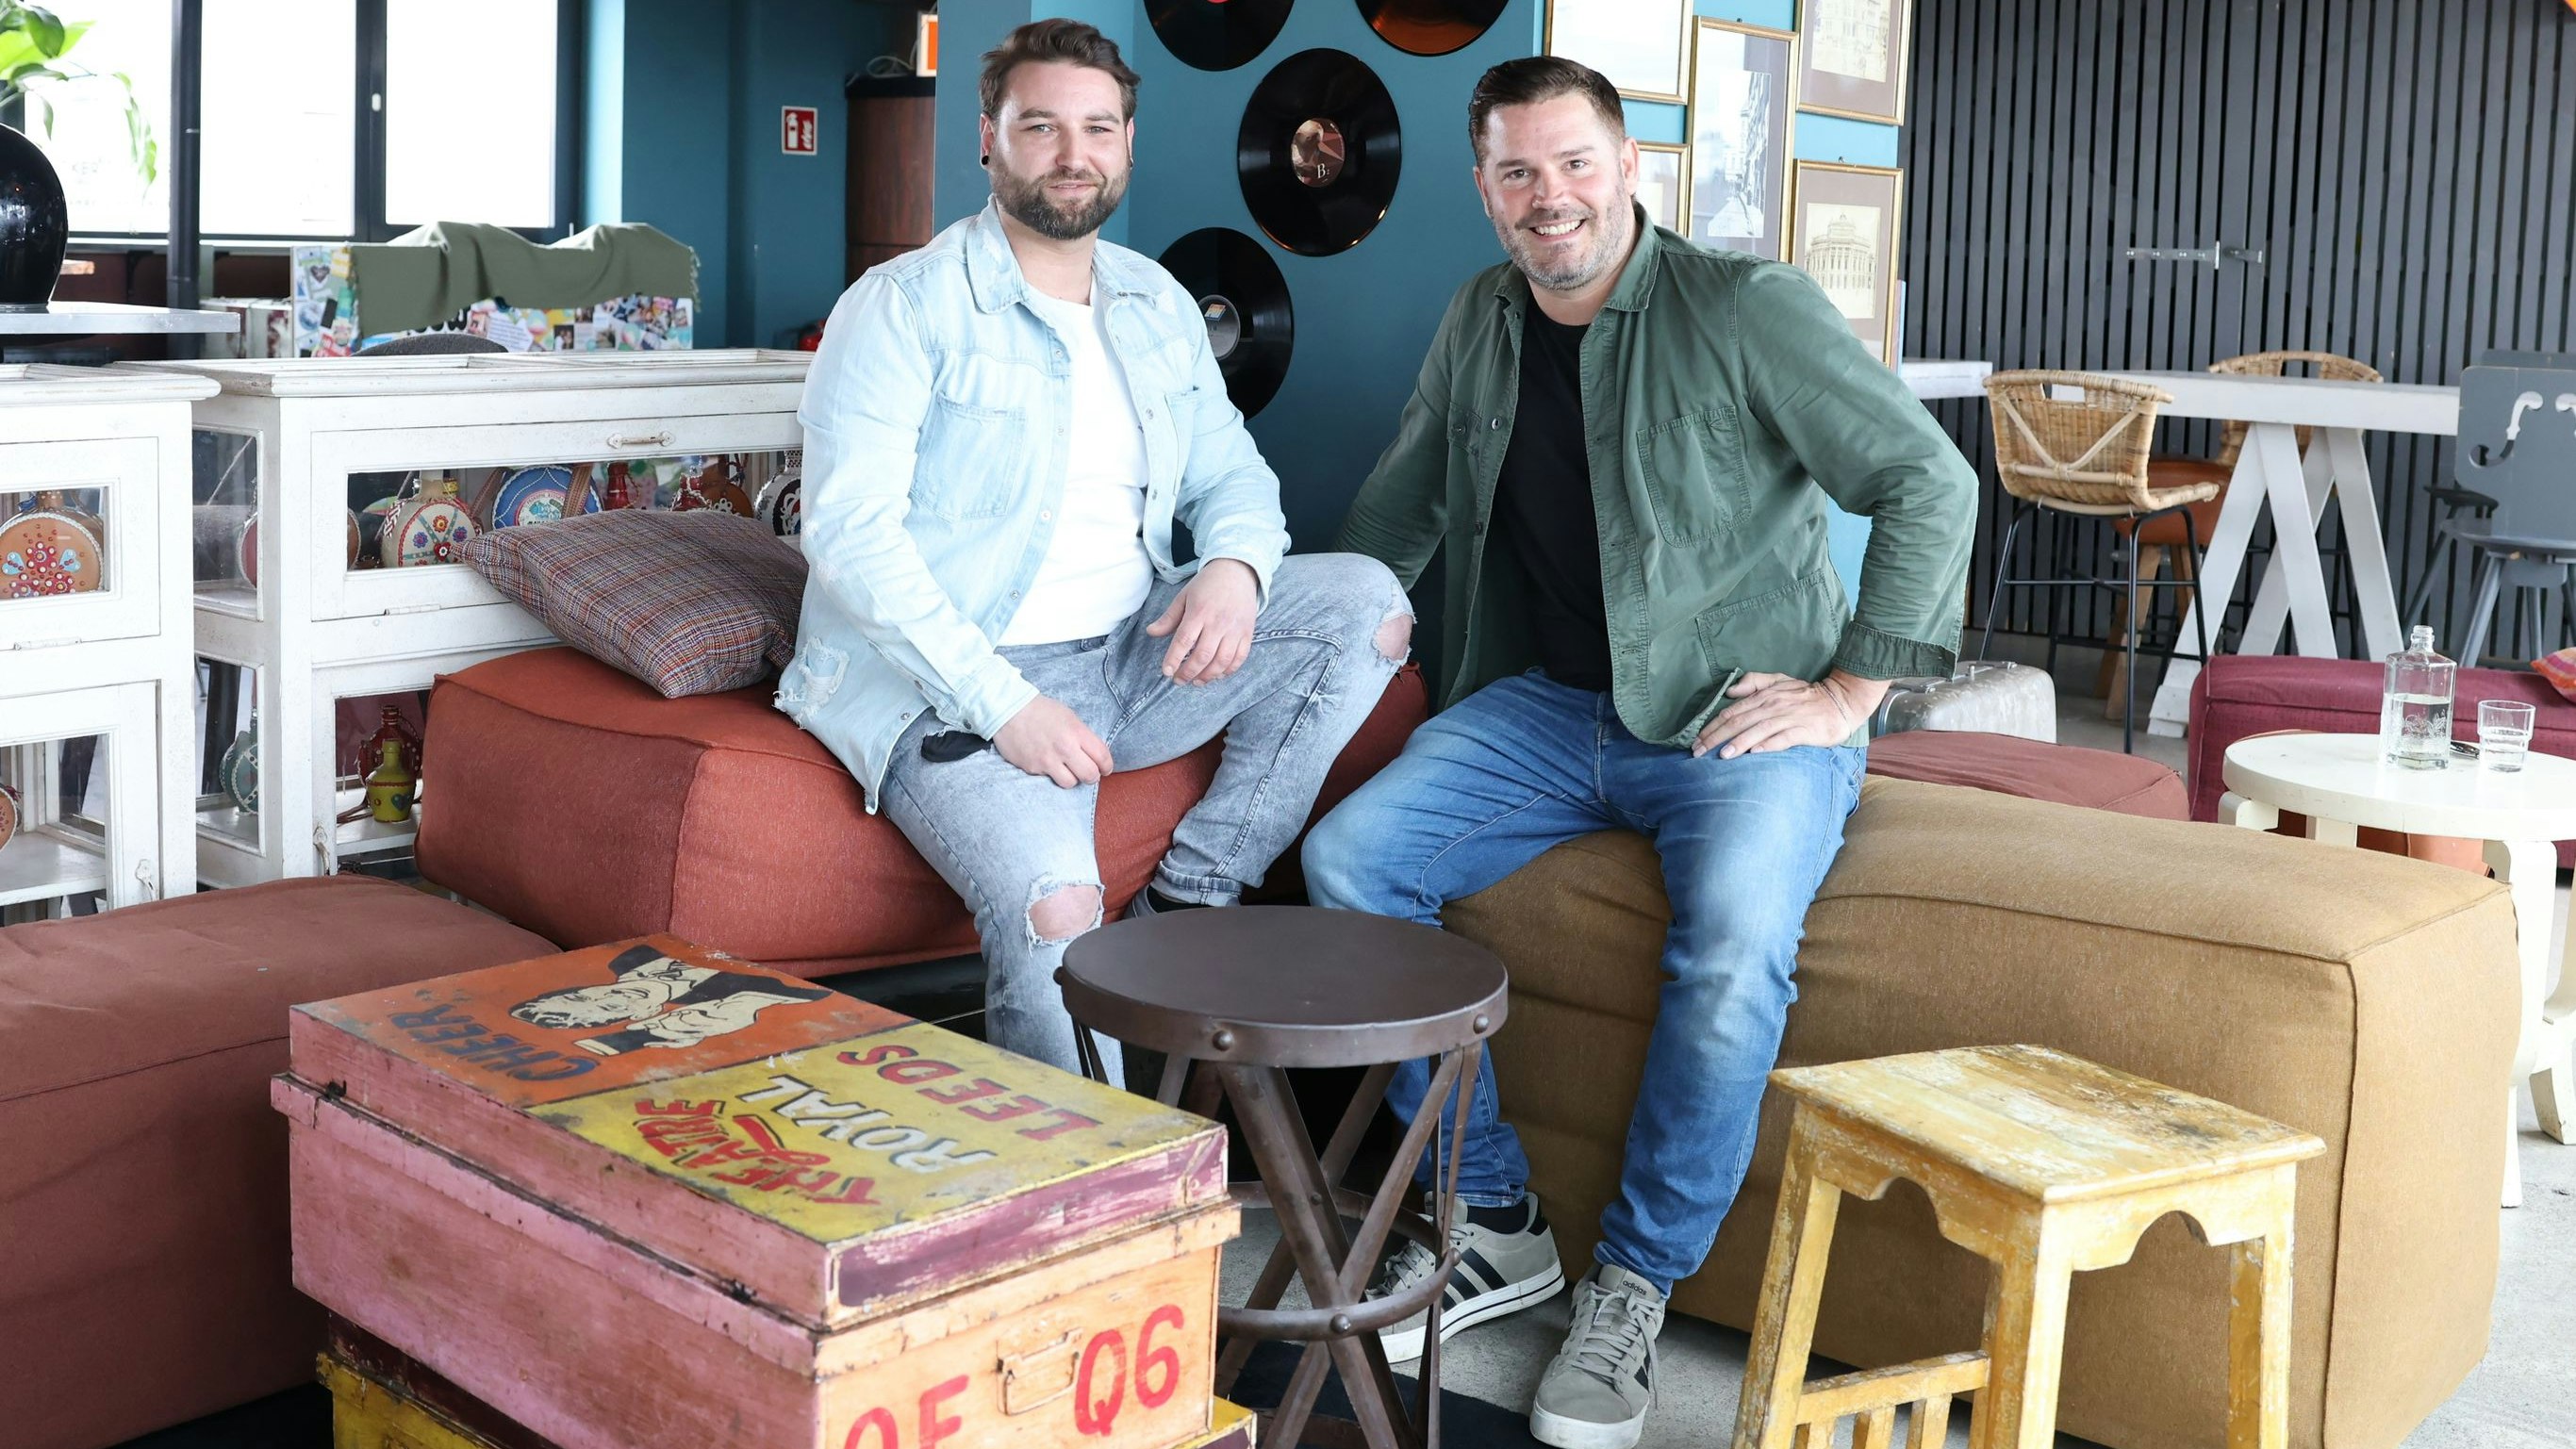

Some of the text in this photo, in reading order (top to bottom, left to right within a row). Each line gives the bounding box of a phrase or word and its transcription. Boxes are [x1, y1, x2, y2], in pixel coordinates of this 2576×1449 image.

[735, 1074, 999, 1174] ROYAL
[835, 1045, 1104, 1142] LEEDS
[634, 1099, 881, 1205] THEATRE
[1622, 1280, 1647, 1295] adidas
[1073, 1304, 1185, 1437] Q6
